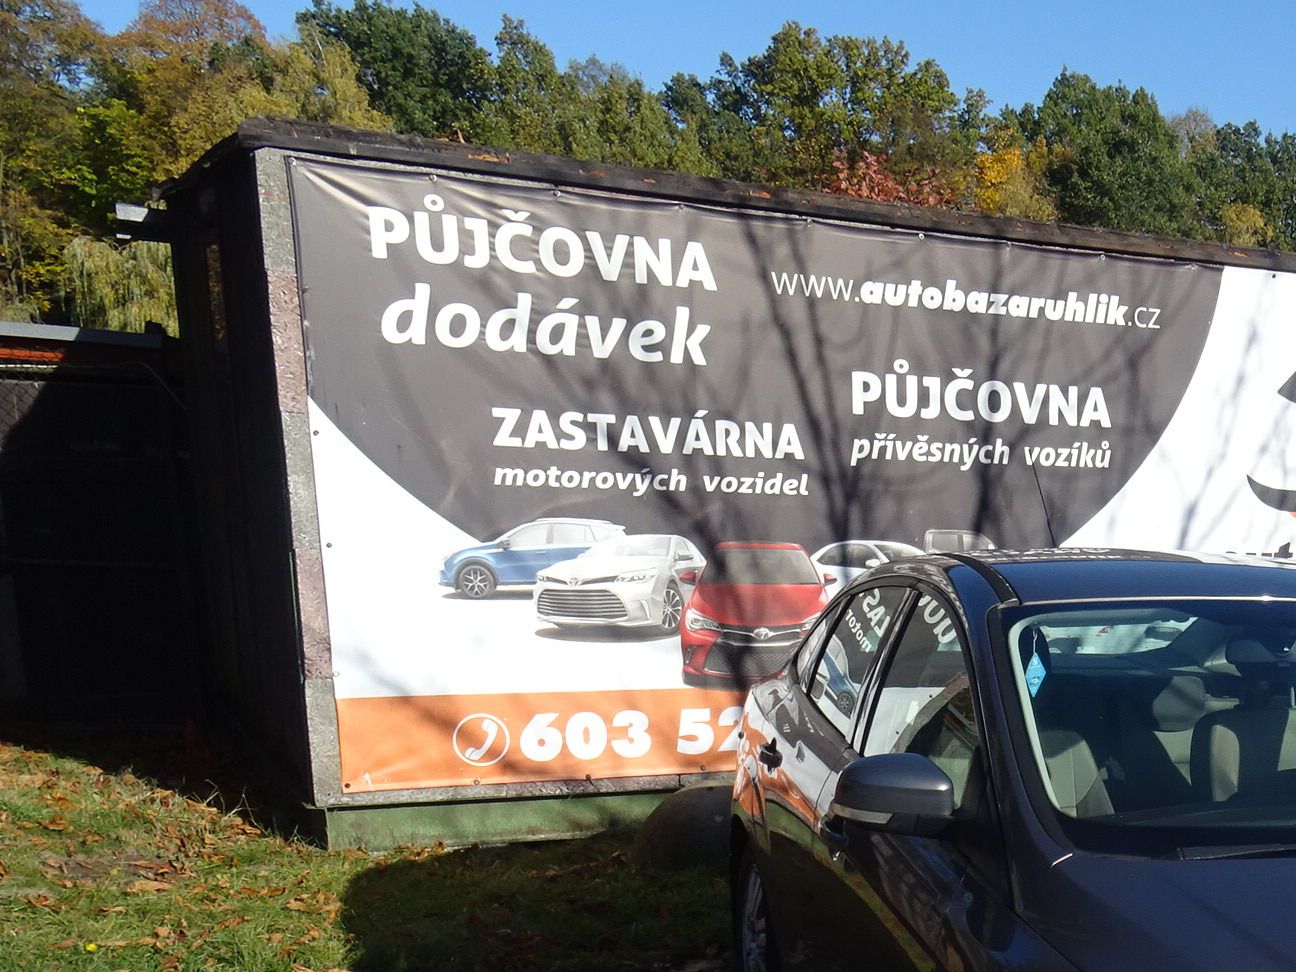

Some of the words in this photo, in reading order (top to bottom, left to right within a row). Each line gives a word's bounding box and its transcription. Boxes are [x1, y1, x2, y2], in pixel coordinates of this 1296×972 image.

[367, 193, 718, 292] PŮJČOVNA
[380, 282, 712, 366] dodávek
[770, 271, 1161, 329] www.autobazaruhlik.cz
[851, 358, 1112, 428] PŮJČOVNA
[491, 408, 806, 460] ZASTAVÁRNA
[850, 432, 1010, 472] přívěsných
[1023, 440, 1112, 469] vozíků
[493, 465, 687, 497] motorových
[702, 471, 809, 496] vozidel
[519, 710, 652, 763] 603
